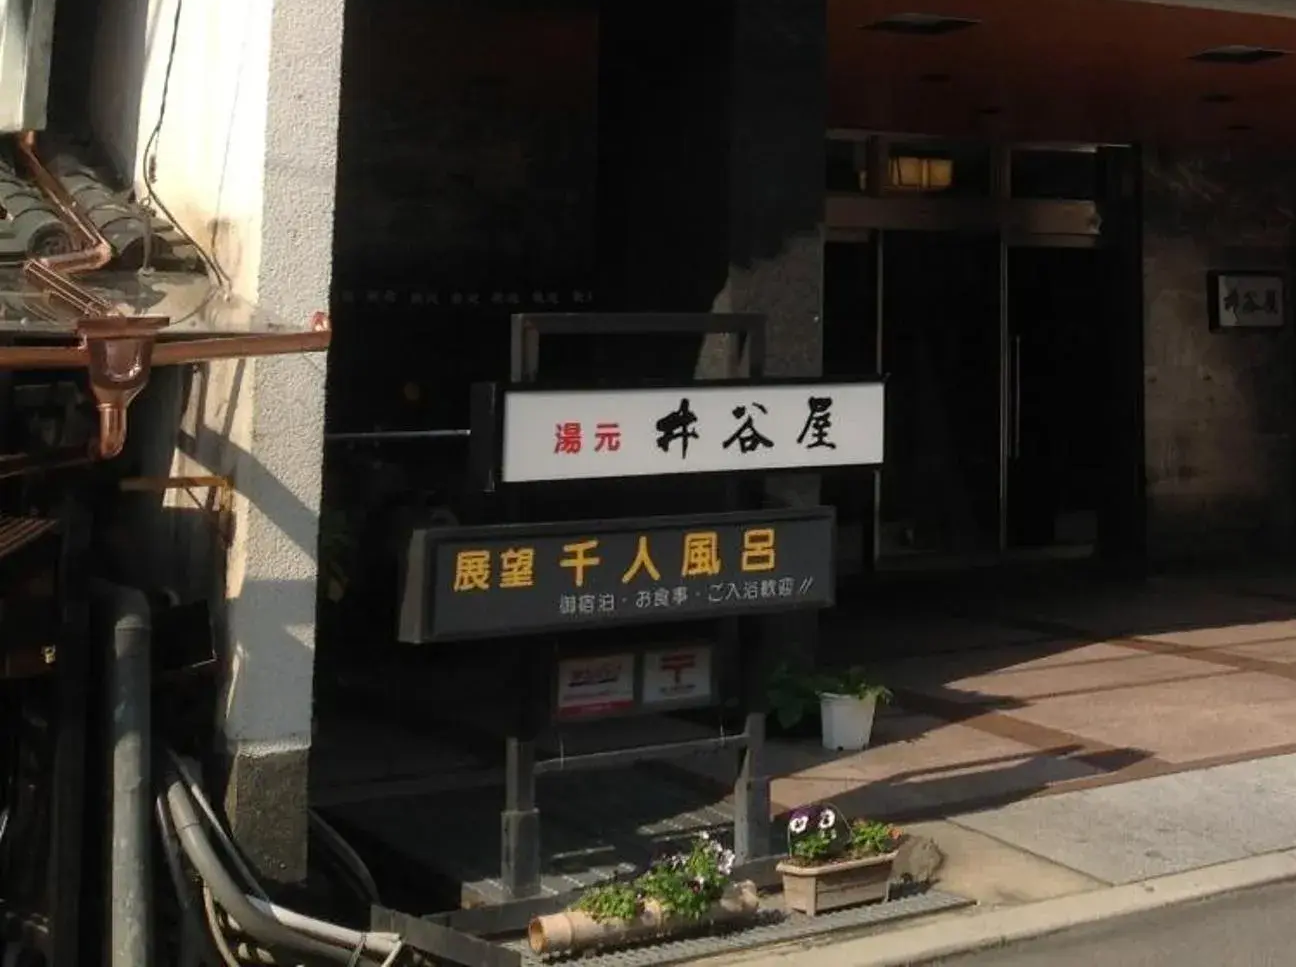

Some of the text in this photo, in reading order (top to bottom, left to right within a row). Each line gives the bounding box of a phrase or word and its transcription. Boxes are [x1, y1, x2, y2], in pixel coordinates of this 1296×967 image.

[553, 396, 839, 459] 湯元 井谷屋
[452, 528, 777, 593] 展望 千人風呂
